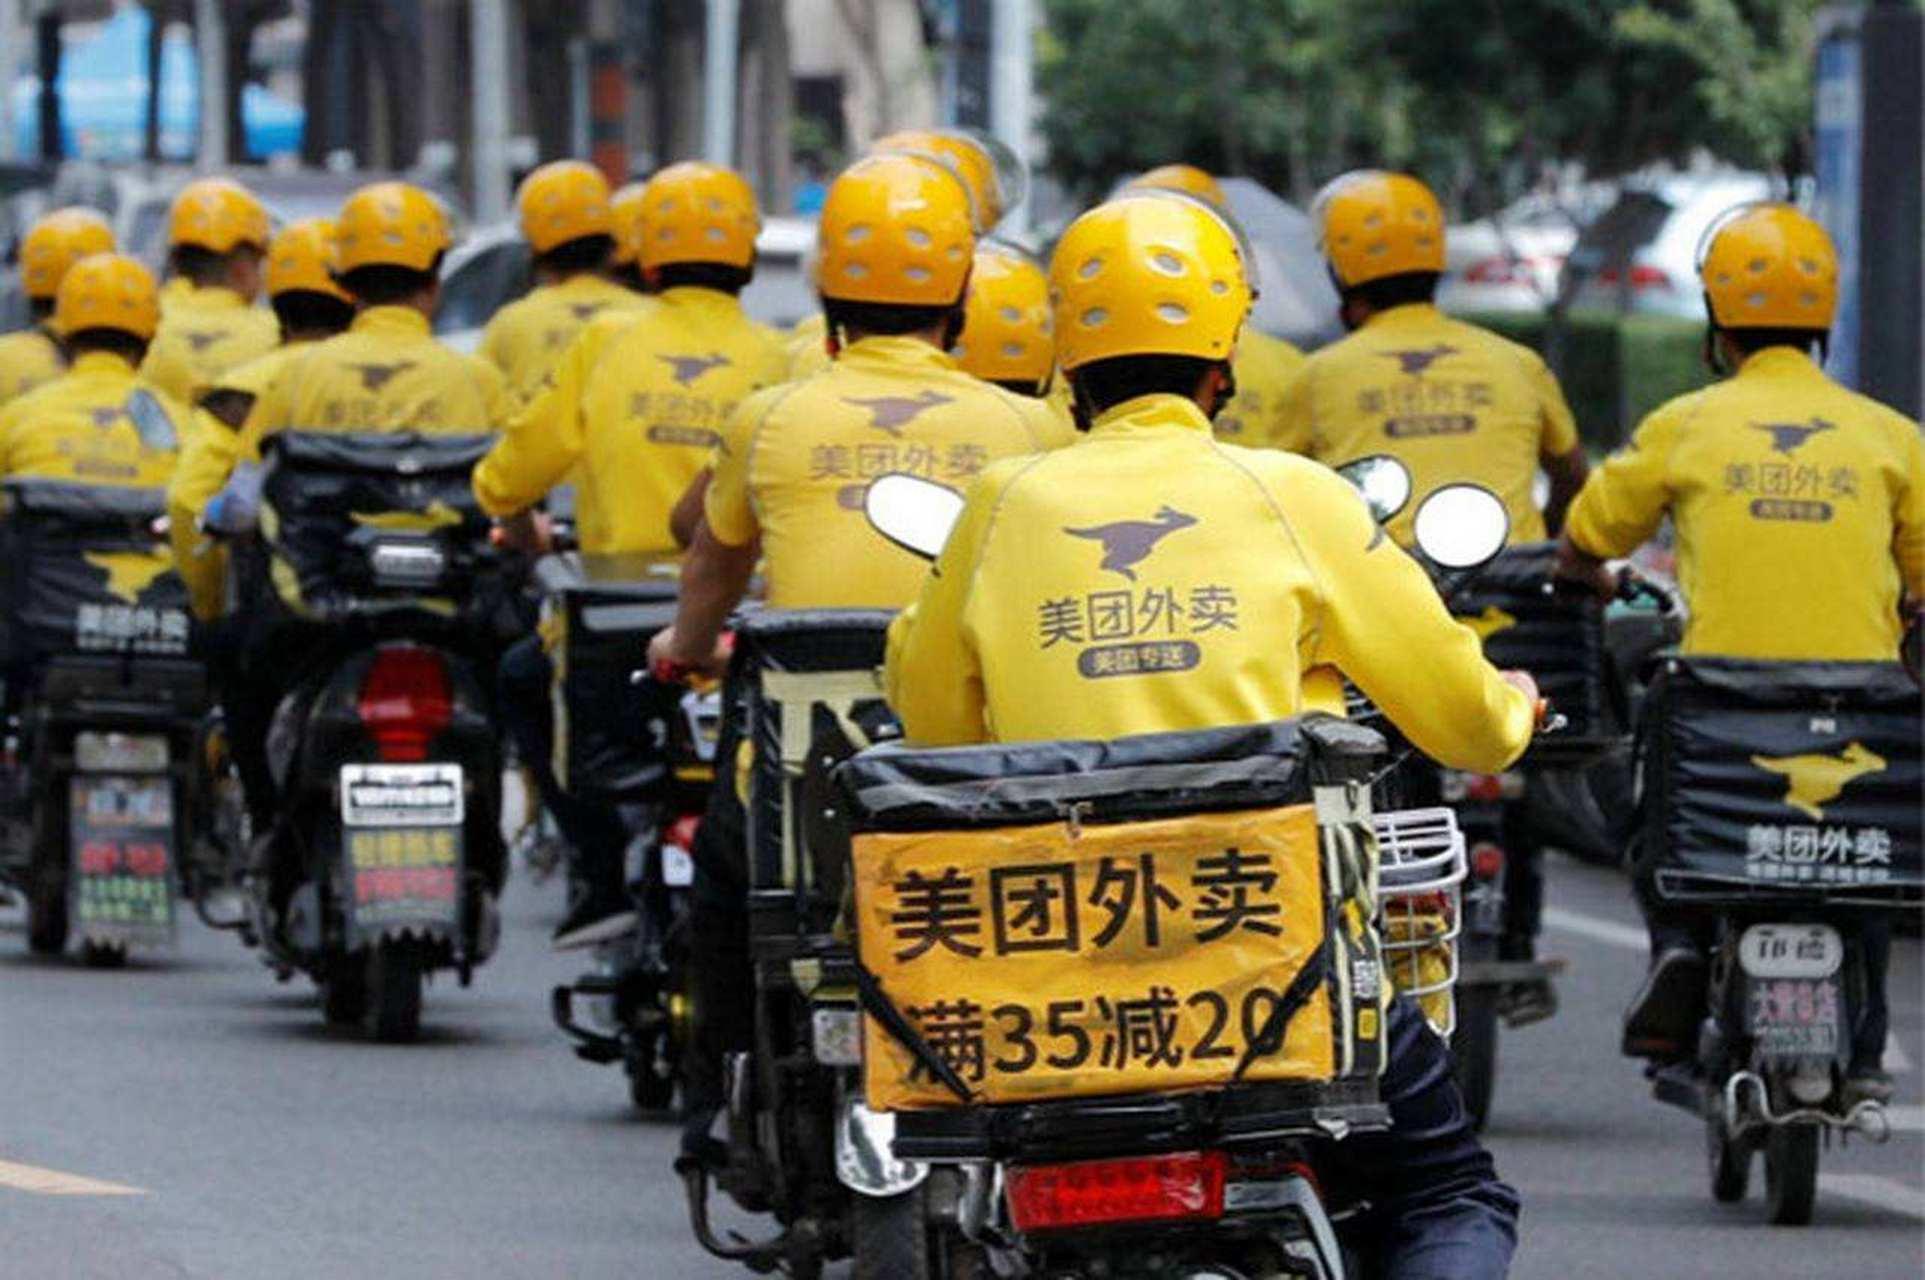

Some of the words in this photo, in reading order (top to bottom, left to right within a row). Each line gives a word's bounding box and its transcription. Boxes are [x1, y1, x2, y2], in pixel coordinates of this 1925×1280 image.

[807, 442, 987, 480] 美团外卖
[1725, 462, 1860, 498] 美团外卖
[1039, 584, 1238, 649] 美团外卖
[1746, 823, 1891, 864] 美团外卖
[891, 847, 1284, 963] 美团外卖
[907, 986, 1288, 1083] 满35减20
